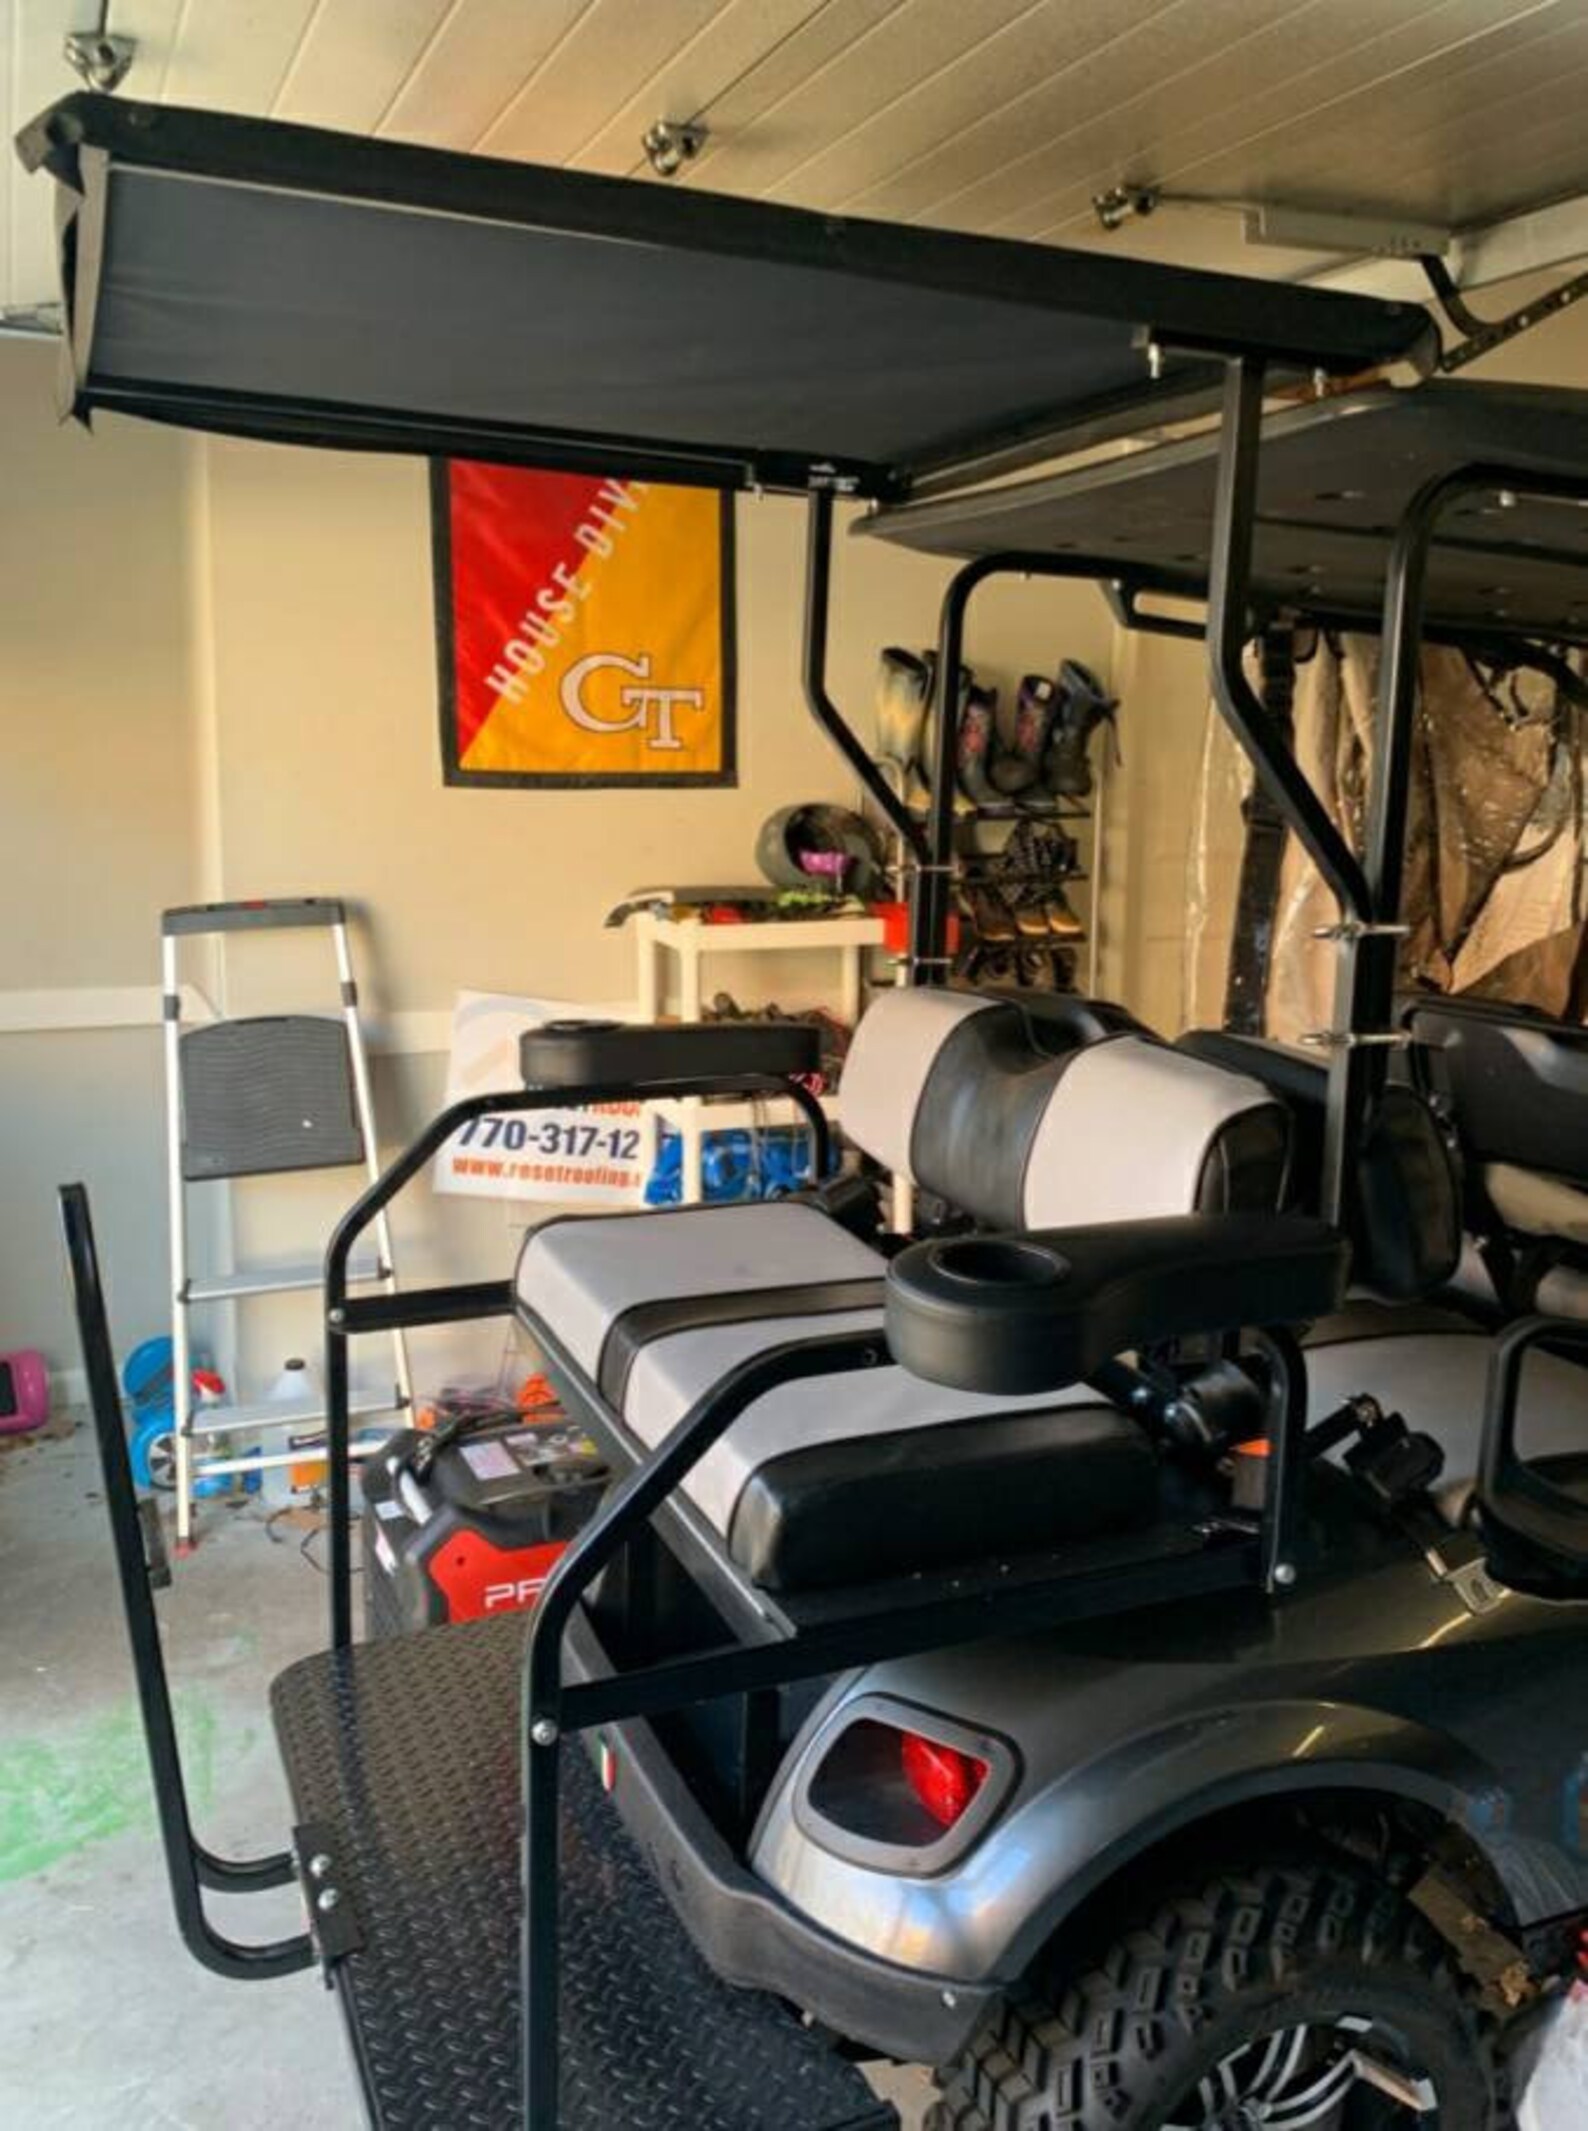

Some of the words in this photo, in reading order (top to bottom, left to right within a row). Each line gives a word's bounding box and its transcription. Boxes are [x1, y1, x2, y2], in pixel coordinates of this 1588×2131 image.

[484, 562, 593, 704] HOUSE
[574, 477, 649, 558] DIV
[559, 653, 704, 749] GT
